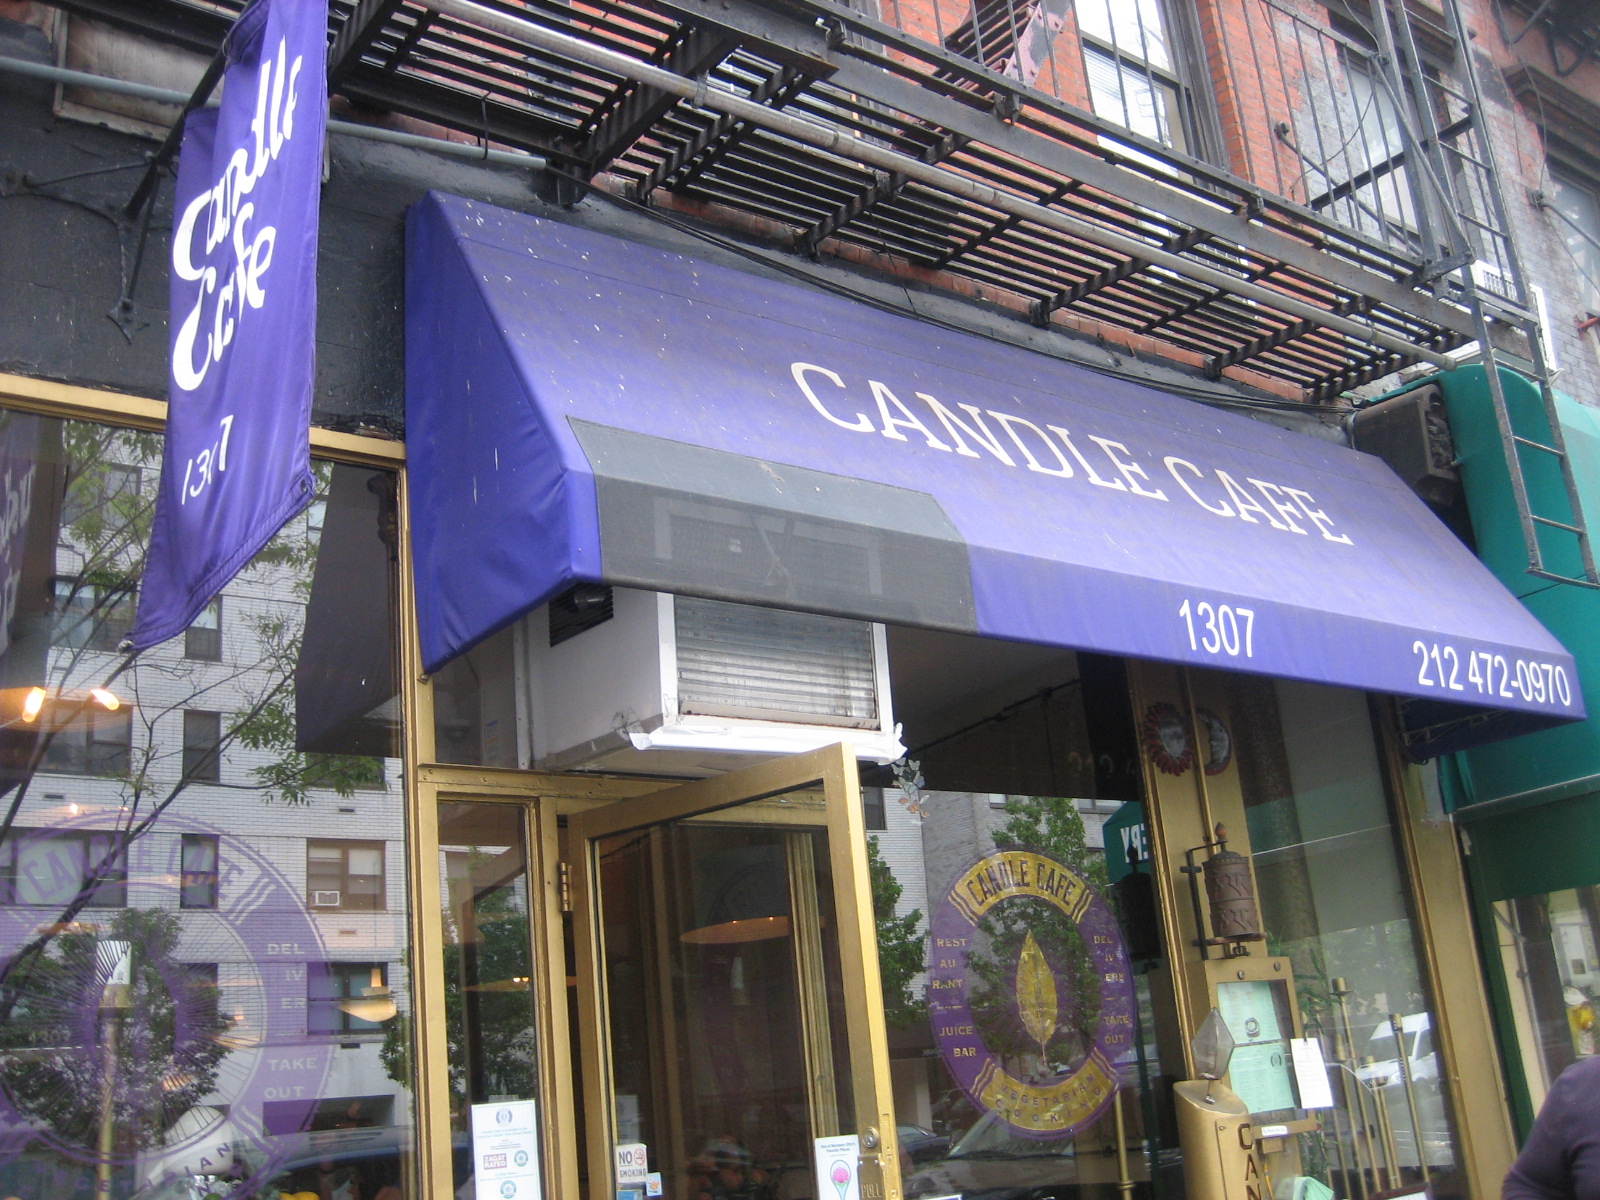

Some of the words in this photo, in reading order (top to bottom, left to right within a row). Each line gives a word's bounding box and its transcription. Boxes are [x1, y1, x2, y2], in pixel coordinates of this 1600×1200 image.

[791, 362, 1169, 501] CANDLE
[1164, 456, 1354, 545] CAFE
[1179, 599, 1254, 658] 1307
[1414, 641, 1464, 690] 212
[1469, 650, 1571, 706] 472-0970
[966, 860, 1030, 906] CANDLE
[1037, 862, 1077, 906] CAFE
[937, 938, 967, 947] REST
[1093, 935, 1113, 944] DEL
[267, 943, 305, 955] DEL
[932, 979, 963, 989] RANT
[1104, 1015, 1129, 1025] TAKE
[940, 1025, 973, 1037] JUICE
[1104, 1034, 1124, 1044] OUT
[953, 1047, 977, 1057] BAR
[267, 1058, 317, 1071] TAKE
[264, 1086, 304, 1099] OUT
[1001, 1074, 1095, 1106] VEGETARIAN
[484, 1154, 506, 1162] ZAGAT
[618, 1151, 633, 1165] NO
[620, 1168, 647, 1178] SMOKING
